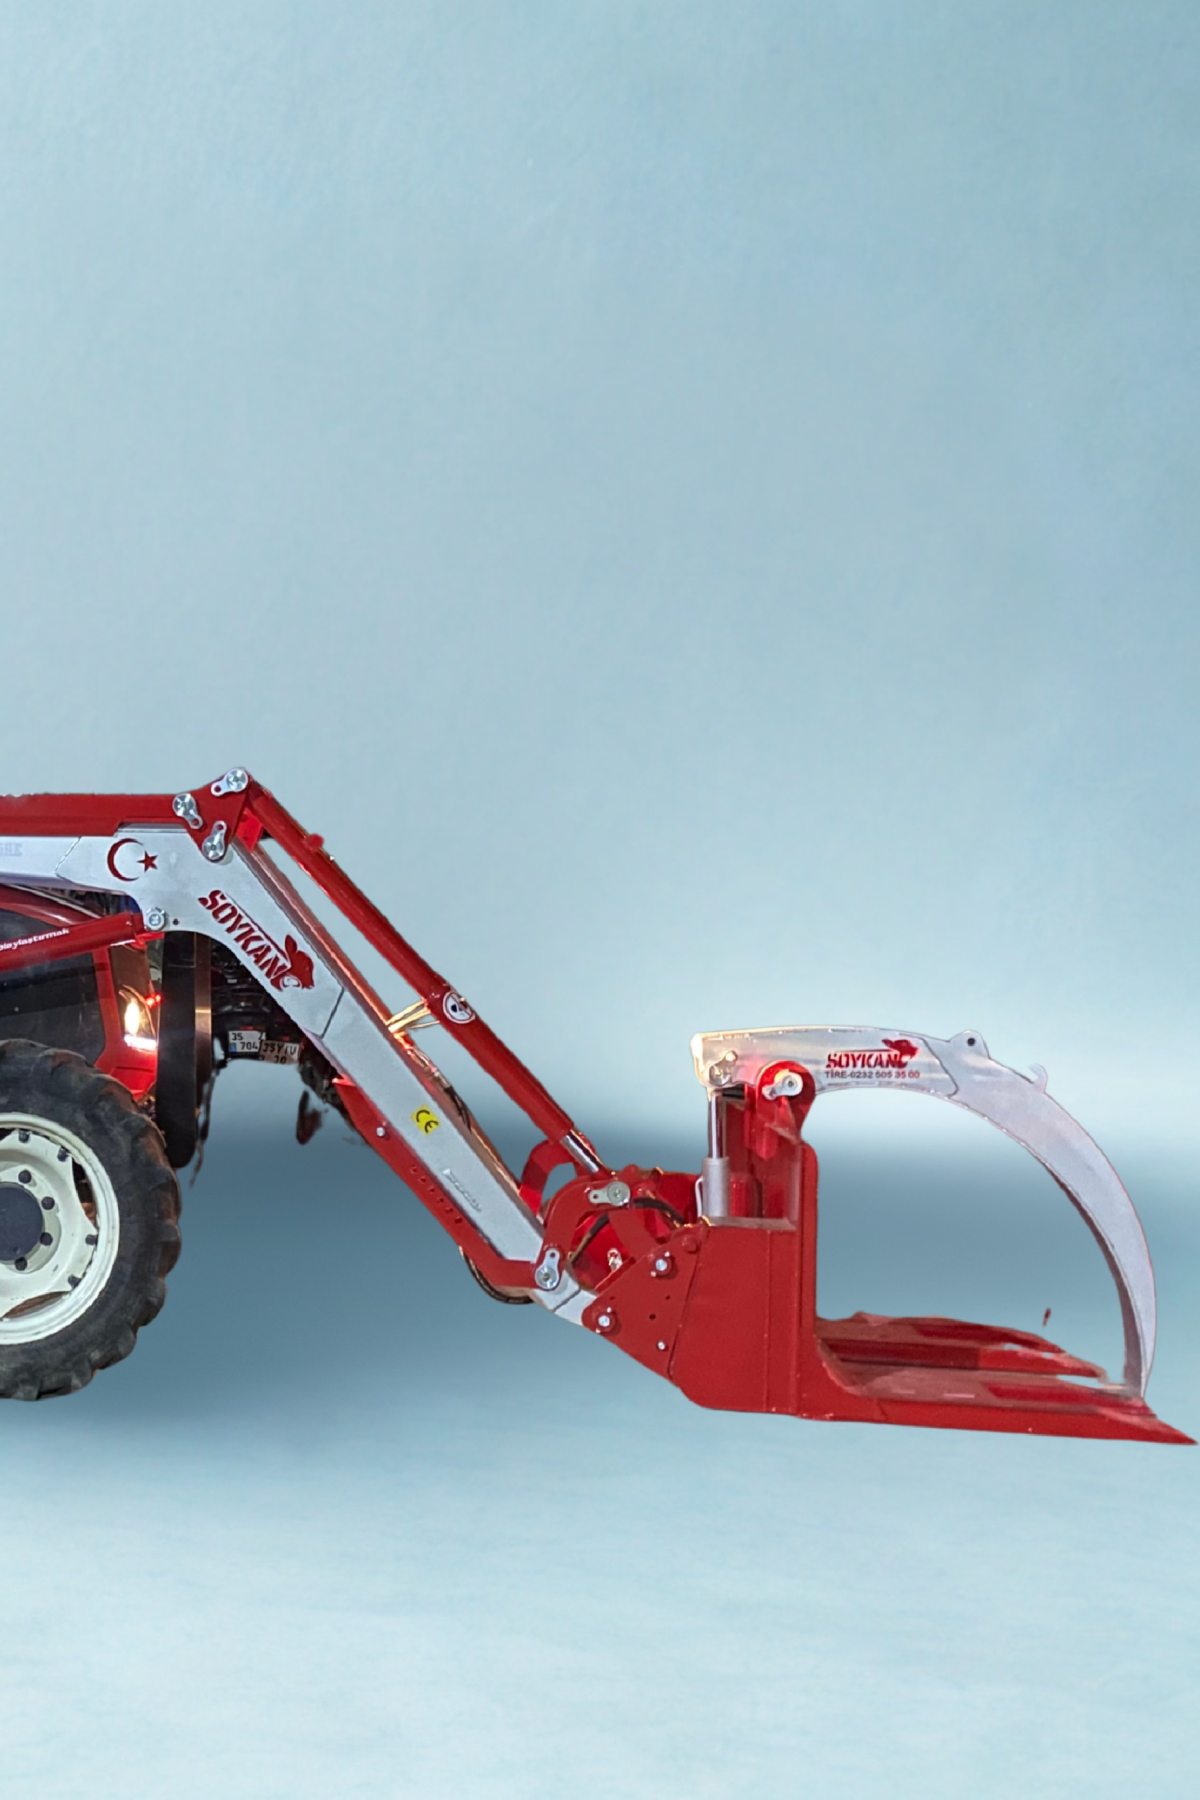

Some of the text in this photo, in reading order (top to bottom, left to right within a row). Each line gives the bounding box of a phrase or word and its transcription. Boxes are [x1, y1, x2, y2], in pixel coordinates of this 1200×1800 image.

[198, 889, 289, 982] SOYKAN
[826, 1053, 901, 1069] SOYKAN
[416, 1109, 439, 1133] CE
